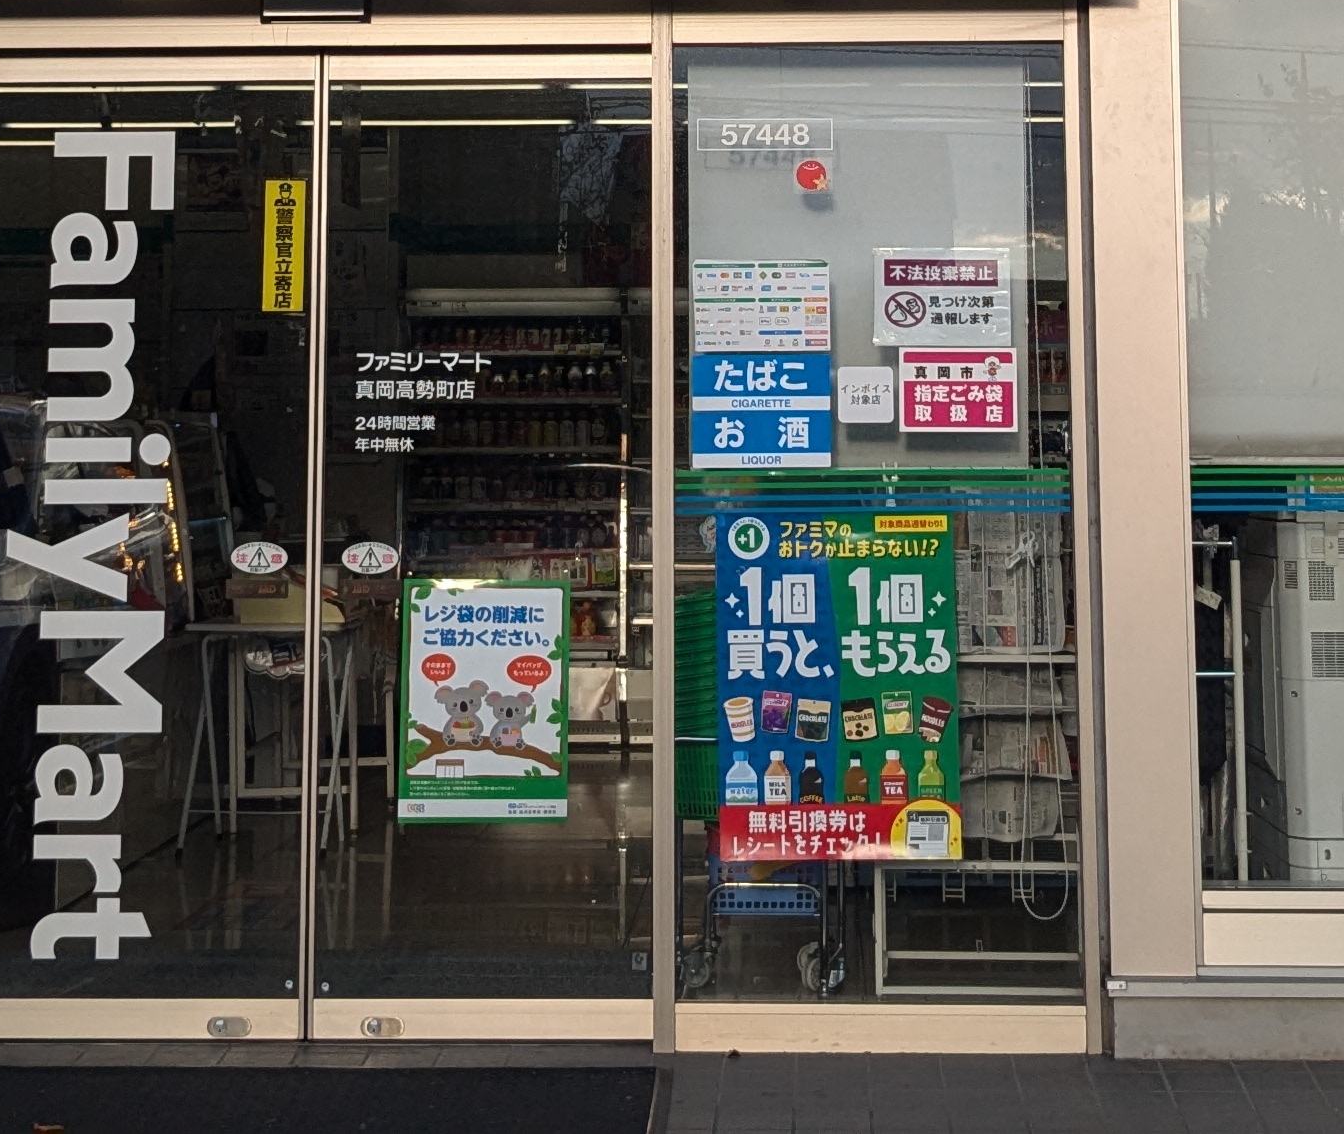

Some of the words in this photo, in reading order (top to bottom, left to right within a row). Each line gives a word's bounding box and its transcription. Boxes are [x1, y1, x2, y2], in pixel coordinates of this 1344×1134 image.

[720, 123, 811, 146] 57448
[274, 208, 294, 309] 警察官立寄店
[889, 264, 994, 281] 不法投棄禁止
[928, 295, 995, 308] 見つけ次第
[929, 312, 994, 325] 通報します
[356, 352, 492, 372] ファミリーマート
[713, 359, 808, 392] たばこ
[914, 366, 974, 379] 真岡市
[356, 380, 476, 399] 真岡高勢町店
[840, 384, 891, 394] インボイス
[913, 384, 1003, 402] 指定ごみ袋
[731, 398, 792, 408] CIGARETTE
[850, 395, 882, 405] 対象店
[913, 404, 1003, 422] 取扱店
[355, 415, 436, 431] 24時間営業
[713, 417, 810, 449] お酒
[355, 437, 415, 452] 年中無休
[741, 455, 782, 466] LIQUOR
[780, 521, 852, 538] ファミマの
[6, 130, 176, 962] FamilyMart
[778, 538, 940, 559] おトクが止まらない!?
[739, 566, 817, 626] 1個
[848, 566, 925, 626] 1個
[424, 605, 545, 623] レジ袋の削減に
[422, 629, 551, 647] ご協力ください。
[727, 629, 835, 679] 買うと、
[841, 629, 952, 677] もらえる
[884, 786, 904, 796] TEA
[748, 810, 867, 834] 無料引換券は
